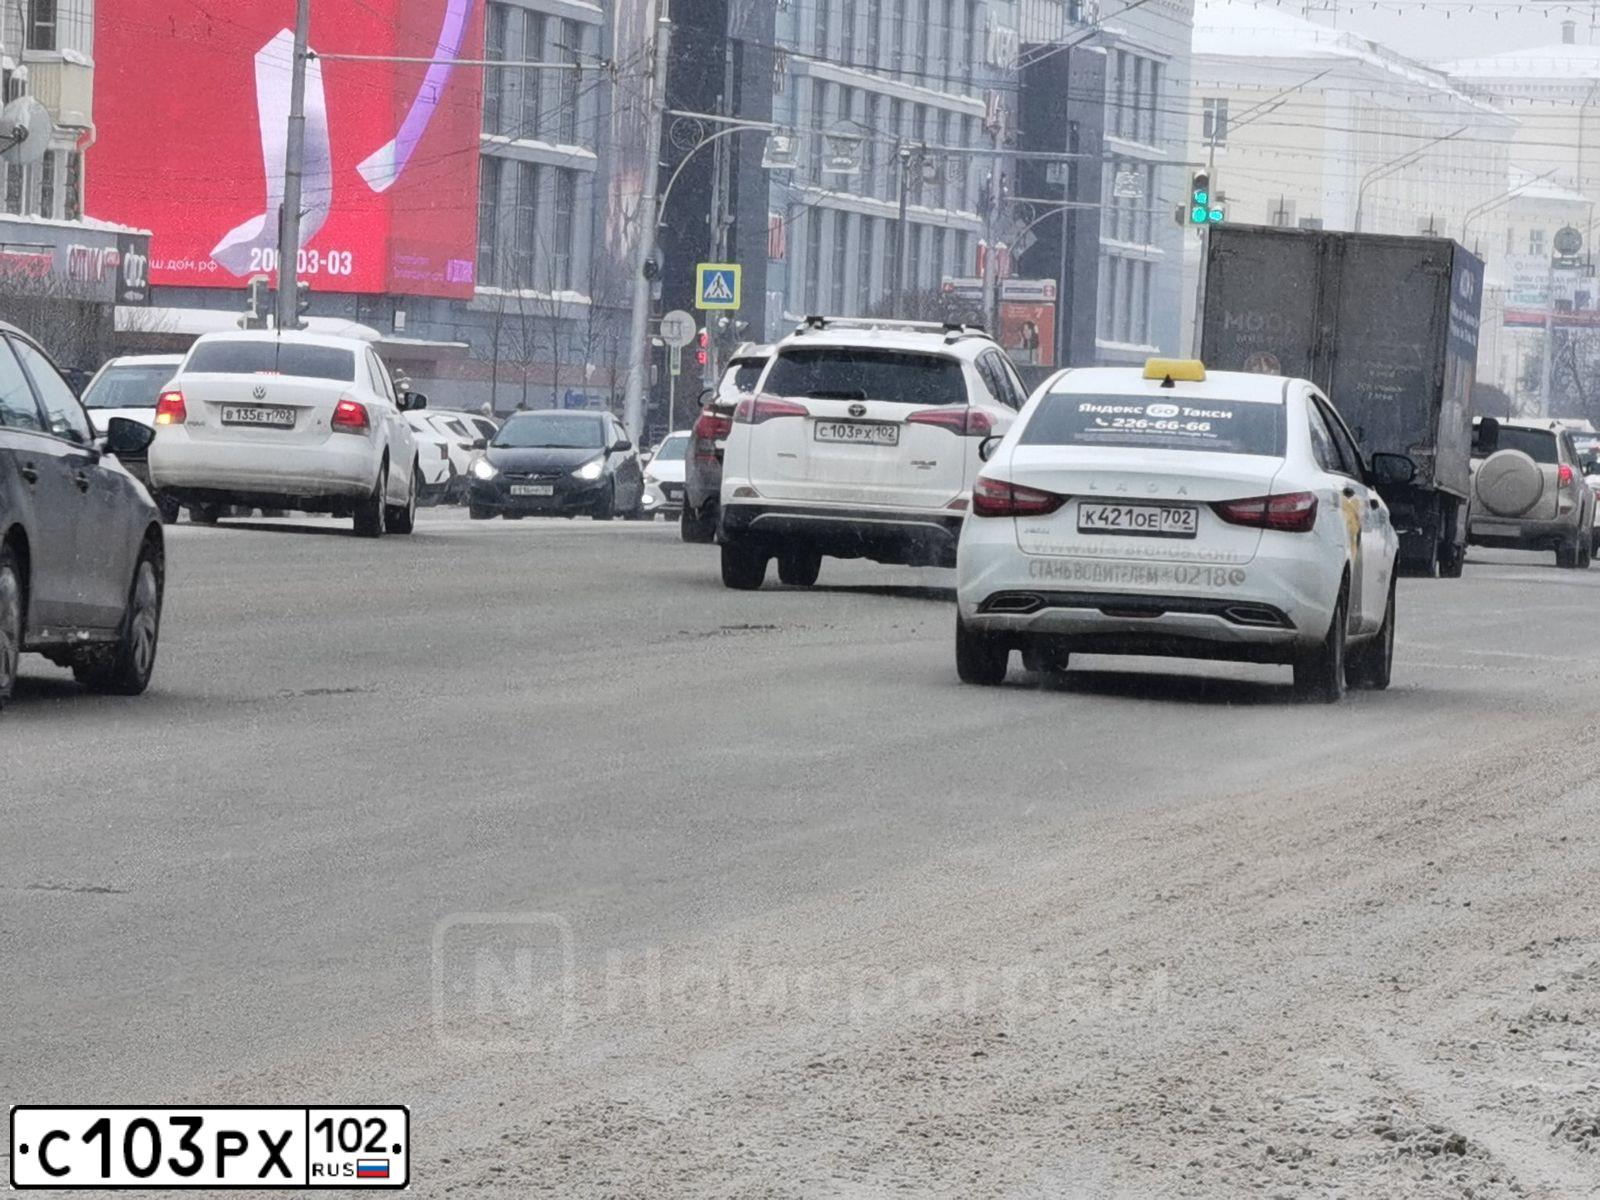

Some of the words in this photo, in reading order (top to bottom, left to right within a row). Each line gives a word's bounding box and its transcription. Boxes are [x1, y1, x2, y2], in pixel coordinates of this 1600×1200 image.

[1078, 403, 1143, 415] Яндекс
[1182, 407, 1233, 419] Такси
[1112, 418, 1211, 431] 226-66-66
[876, 426, 894, 438] 102
[1085, 507, 1158, 528] К421ОЕ
[1162, 509, 1191, 525] 702
